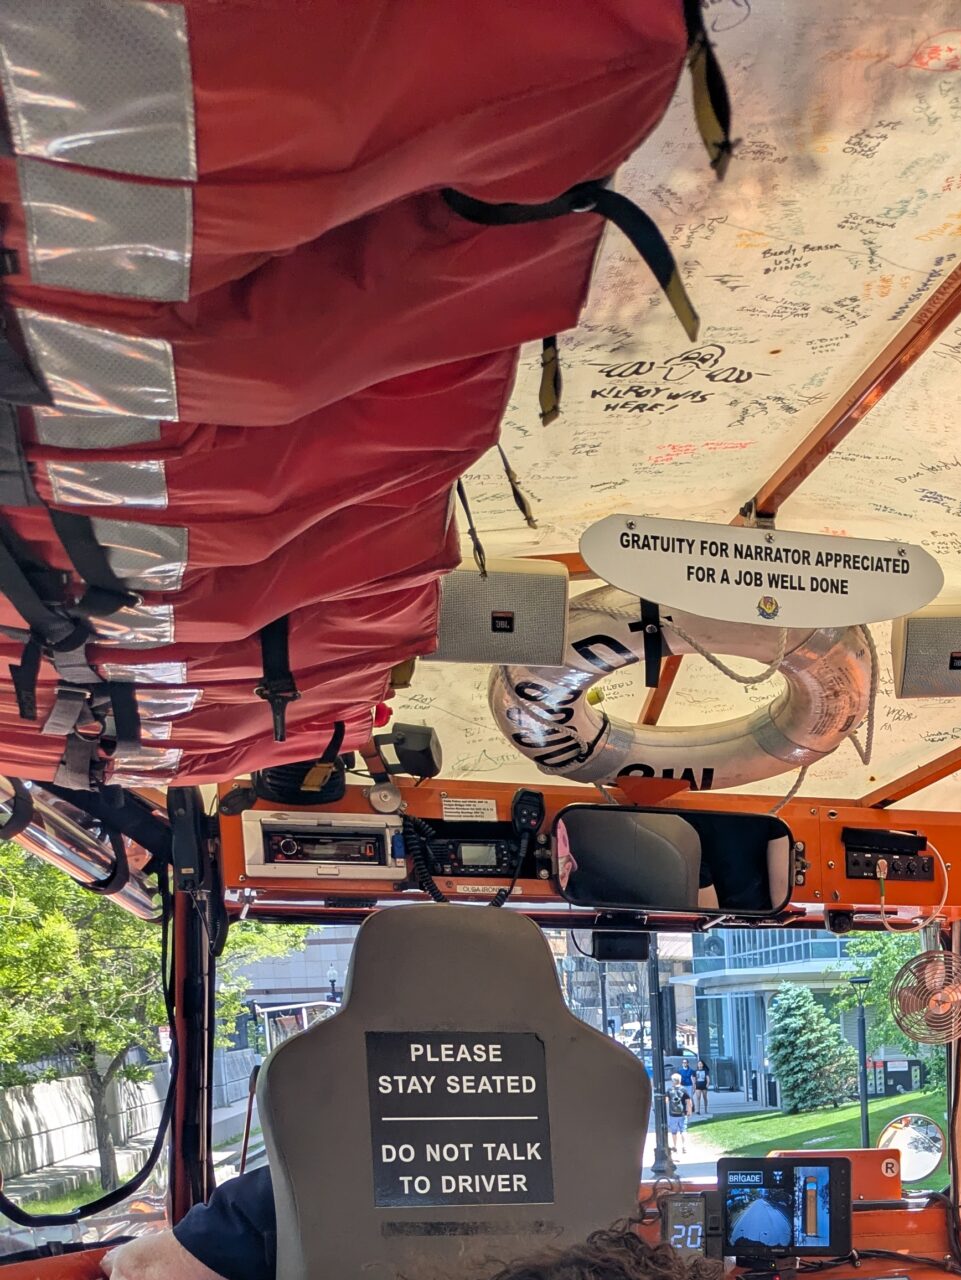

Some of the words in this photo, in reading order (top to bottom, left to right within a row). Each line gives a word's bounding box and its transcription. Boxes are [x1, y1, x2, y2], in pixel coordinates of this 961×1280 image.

[590, 385, 670, 400] KILROY
[666, 389, 715, 403] WAS
[603, 400, 680, 415] HERE!
[619, 532, 696, 556] GRATUITY
[700, 540, 730, 559] FOR
[733, 545, 811, 567] NARRATOR
[814, 550, 910, 575] APPRECIATED
[686, 565, 716, 584] FOR
[720, 569, 731, 585] A
[734, 570, 763, 588] JOB
[767, 573, 806, 591] WELL
[810, 576, 849, 595] DONE
[410, 1044, 502, 1062] PLEASE
[378, 1075, 436, 1094] STAY
[446, 1075, 537, 1093] SEATED
[381, 1144, 415, 1162] DO
[426, 1143, 473, 1162] NOT
[483, 1142, 542, 1161] TALK
[885, 1162, 895, 1174] R
[399, 1176, 431, 1194] TO
[441, 1174, 528, 1193] DRIVER
[728, 1173, 762, 1183] BRIGADE
[671, 1224, 702, 1249] 20
